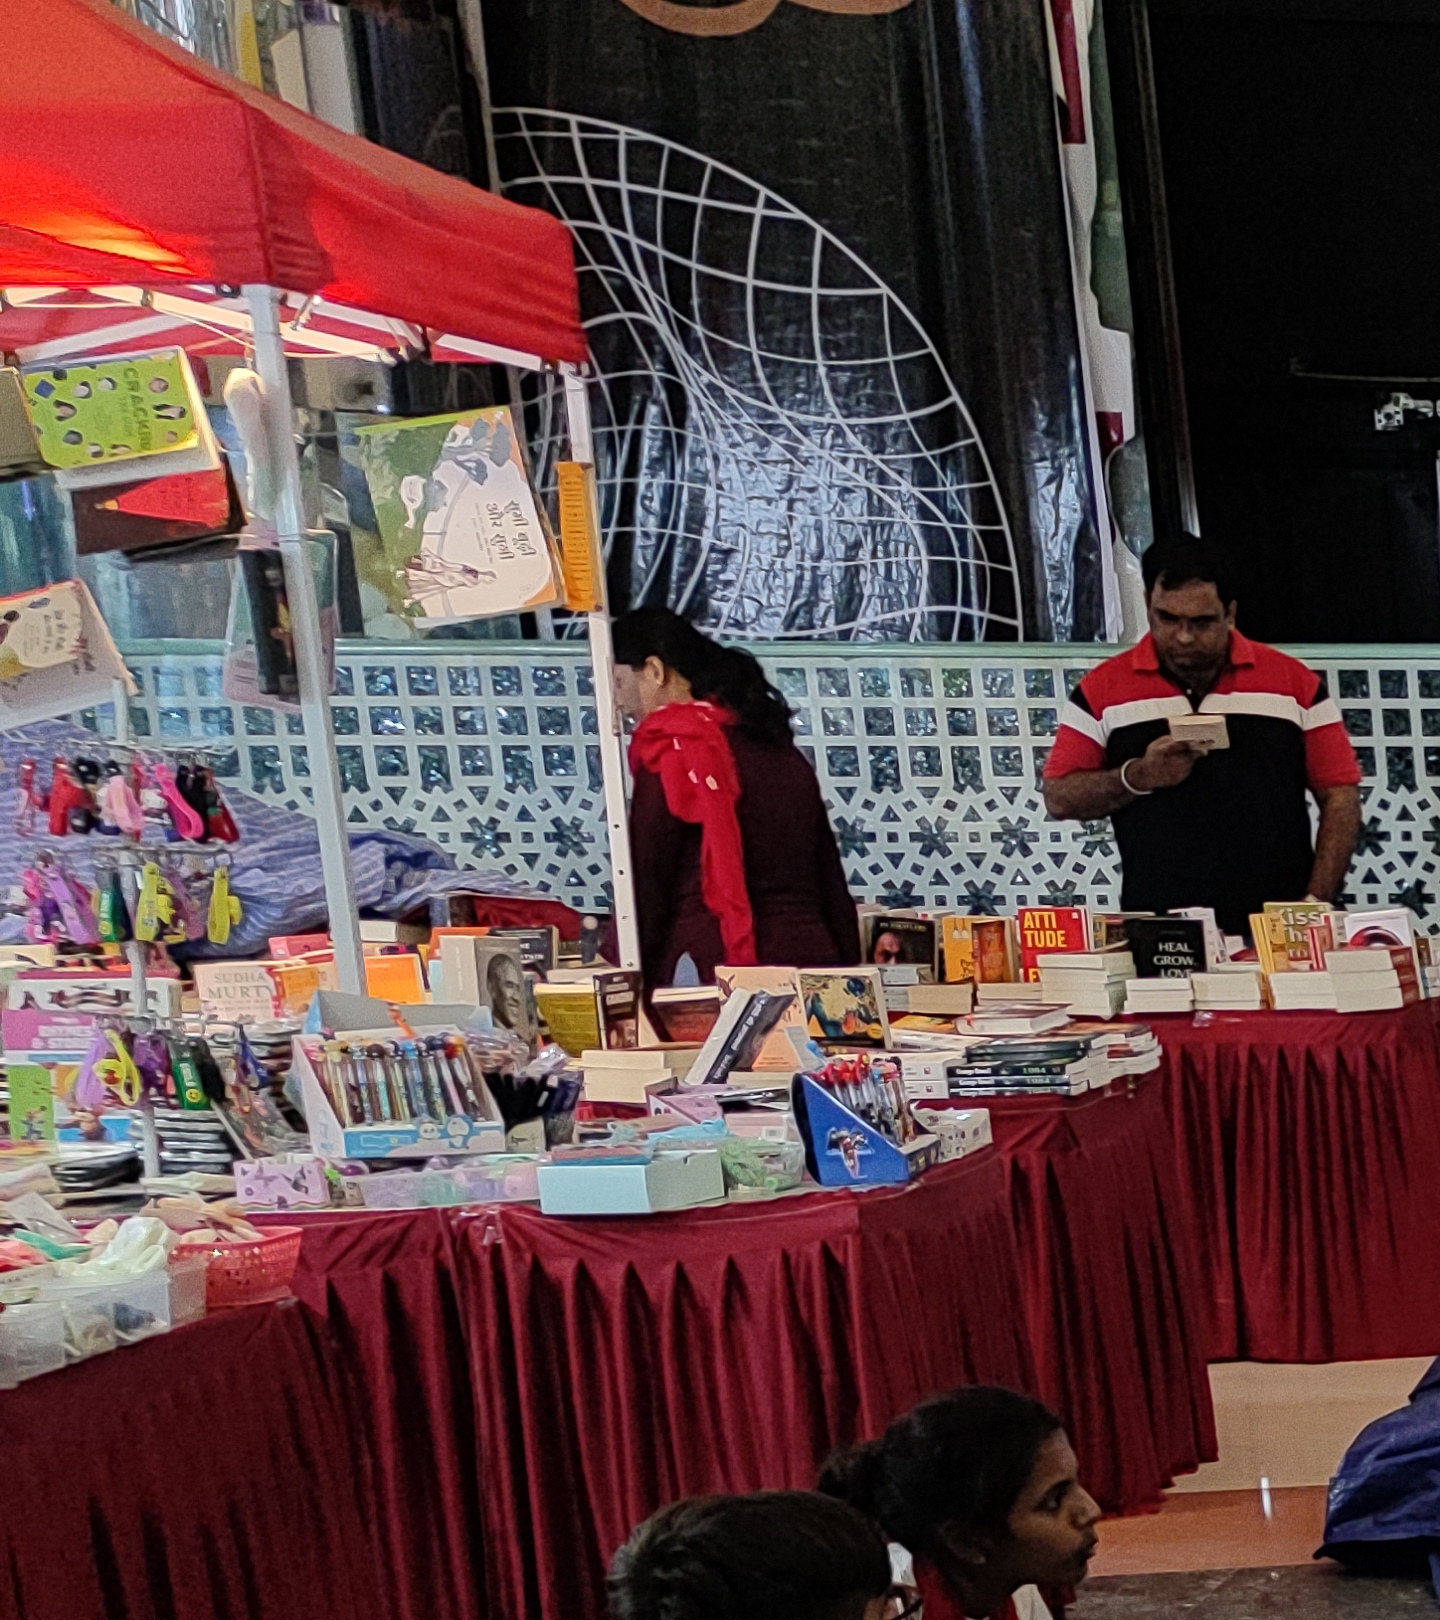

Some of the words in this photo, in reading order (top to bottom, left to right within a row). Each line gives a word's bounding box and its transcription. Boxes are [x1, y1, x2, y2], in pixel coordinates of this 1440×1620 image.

[1024, 911, 1057, 928] ATTI
[1024, 930, 1067, 947] TUDE
[214, 971, 266, 984] SUDHA
[207, 984, 274, 999] MURTY
